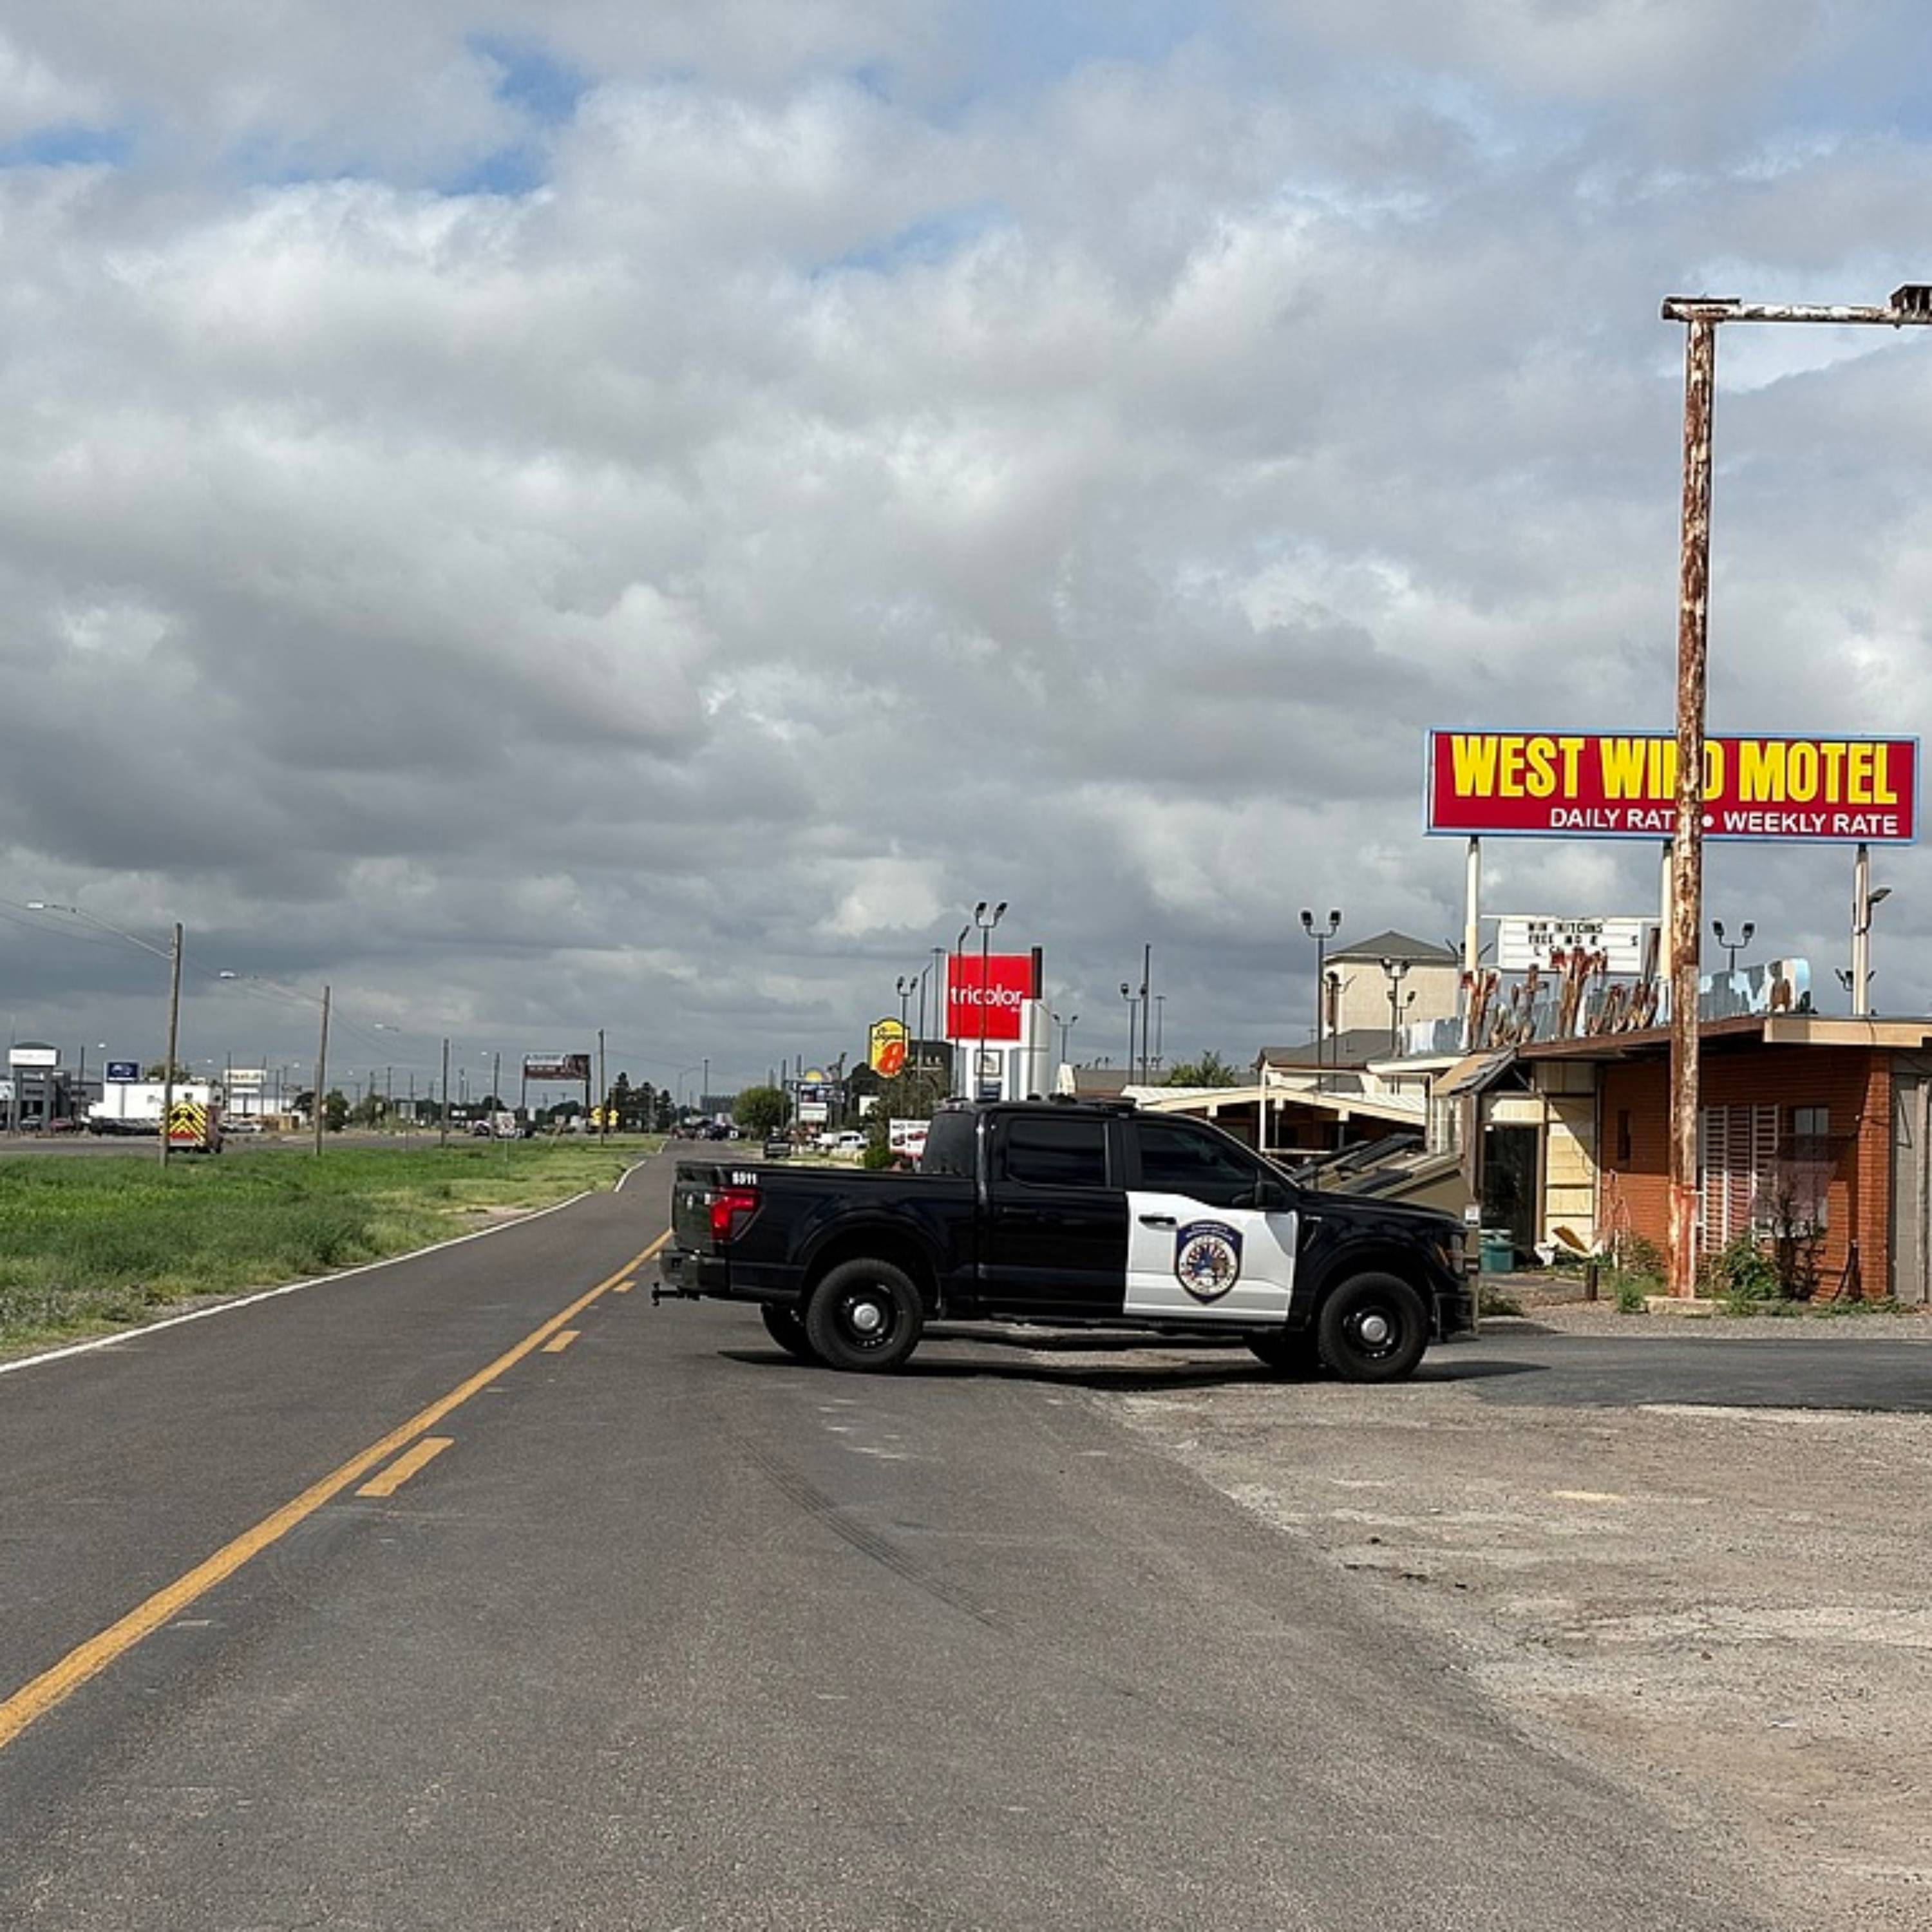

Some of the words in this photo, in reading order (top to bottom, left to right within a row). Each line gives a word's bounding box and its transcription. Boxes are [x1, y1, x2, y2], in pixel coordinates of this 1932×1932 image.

[1450, 734, 1585, 798] WEST
[1739, 741, 1898, 804] MOTEL
[1551, 808, 1620, 828] DAILY
[1627, 810, 1676, 829] RAT
[1723, 811, 1825, 833] WEEKLY
[1833, 814, 1899, 835] RATE
[951, 983, 1023, 1007] tricolor
